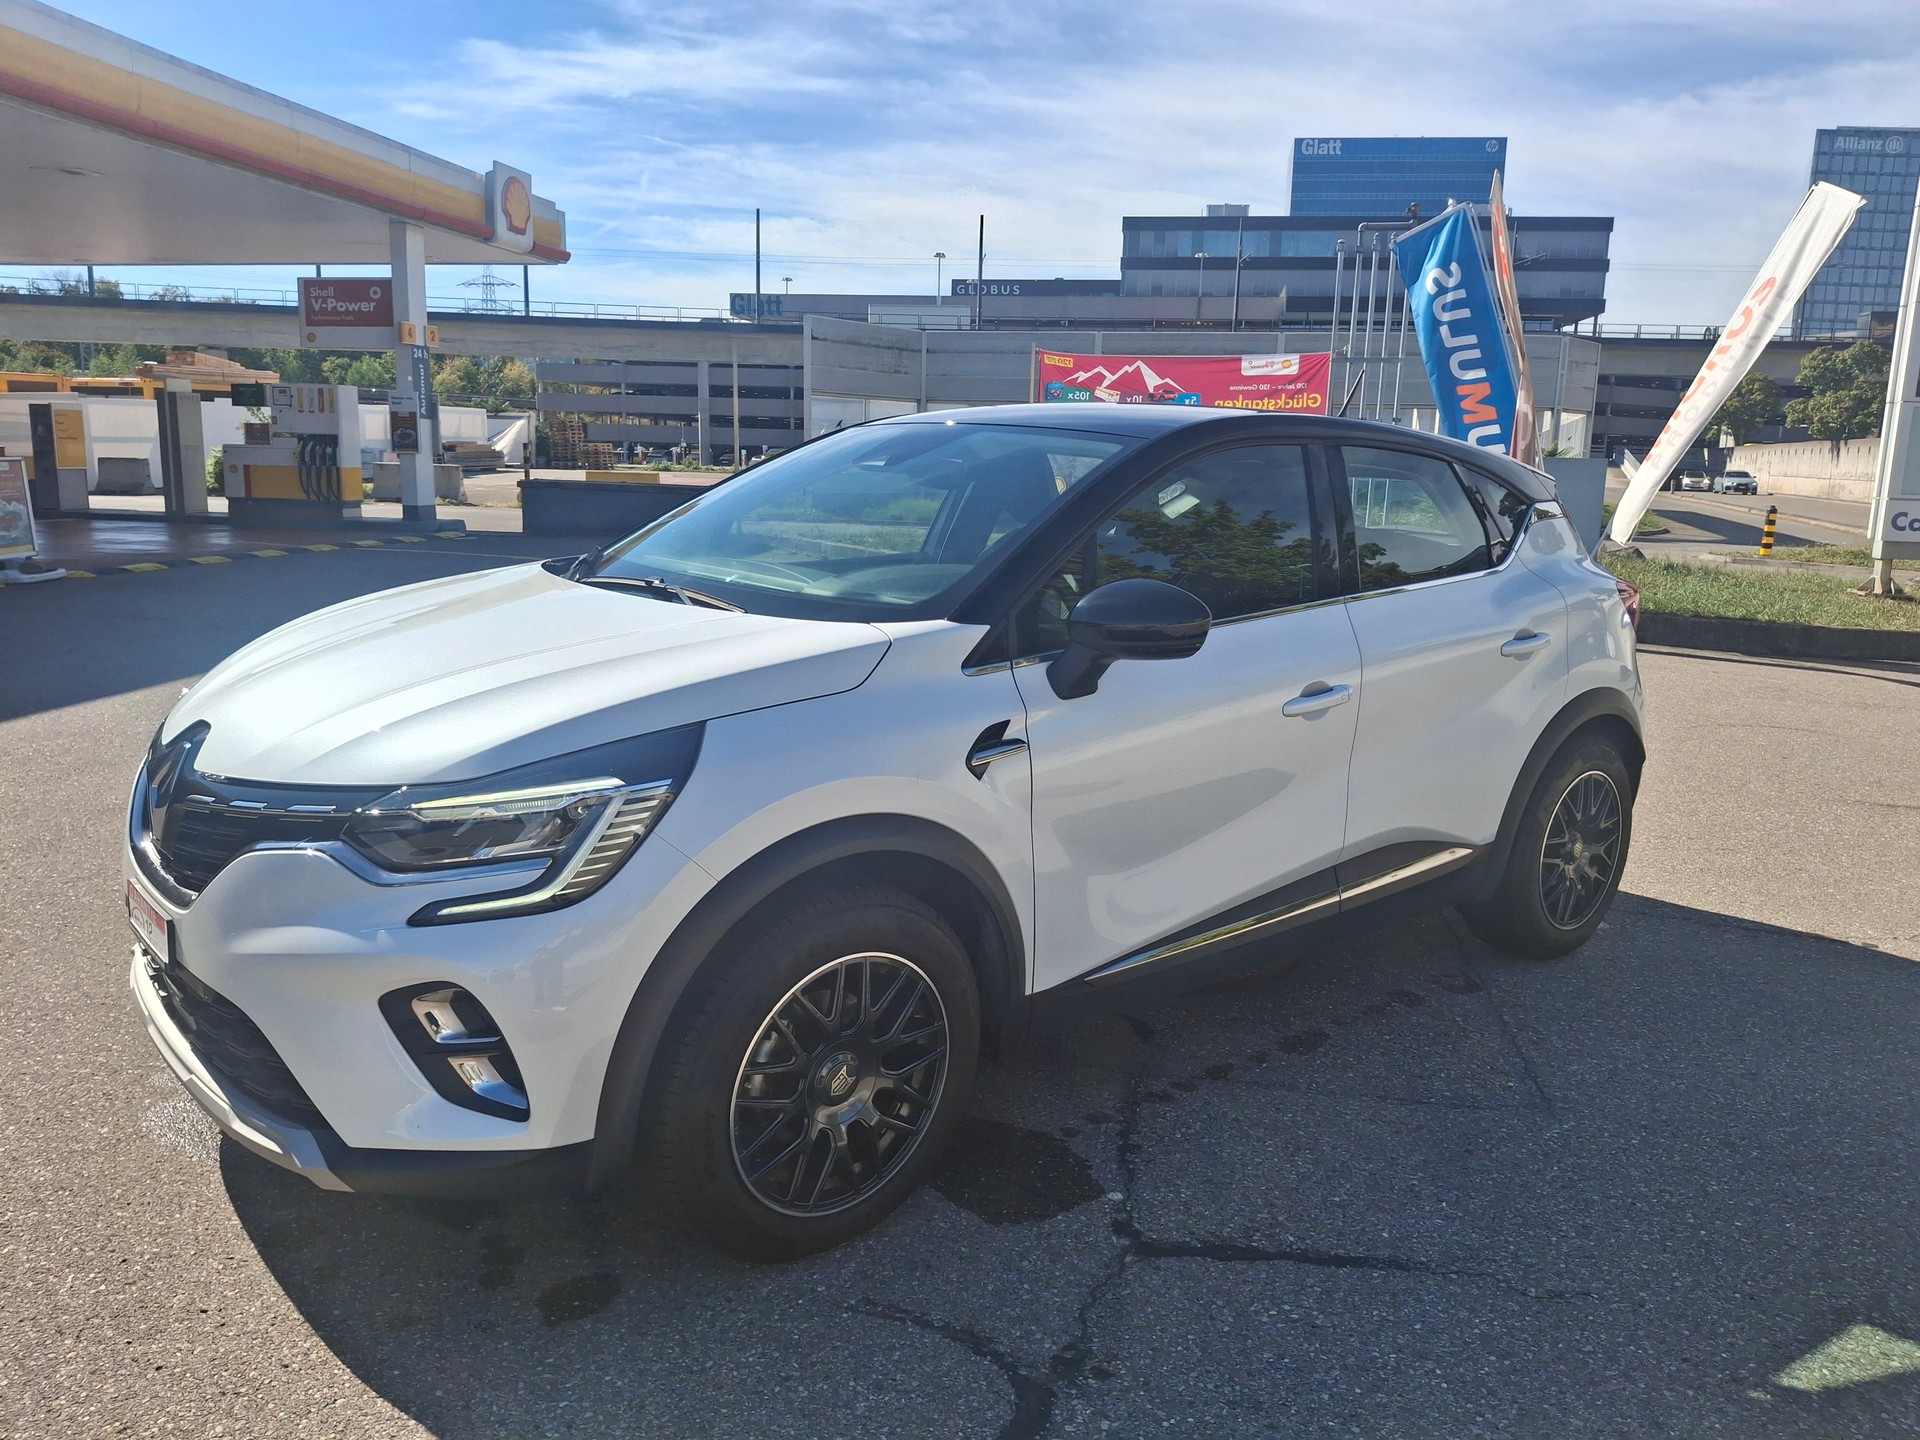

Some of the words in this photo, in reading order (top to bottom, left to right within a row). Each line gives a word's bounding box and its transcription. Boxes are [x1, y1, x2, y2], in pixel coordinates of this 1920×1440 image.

[1301, 139, 1343, 155] Glatt
[1486, 139, 1499, 153] hp
[1834, 136, 1884, 150] Allianz
[310, 286, 334, 297] Shell
[956, 284, 1020, 296] GLOBUS
[311, 298, 376, 311] V-Power
[731, 293, 783, 316] Glatt
[407, 327, 413, 339] 4
[429, 331, 436, 342] 2
[413, 348, 422, 358] 24
[423, 349, 428, 359] h
